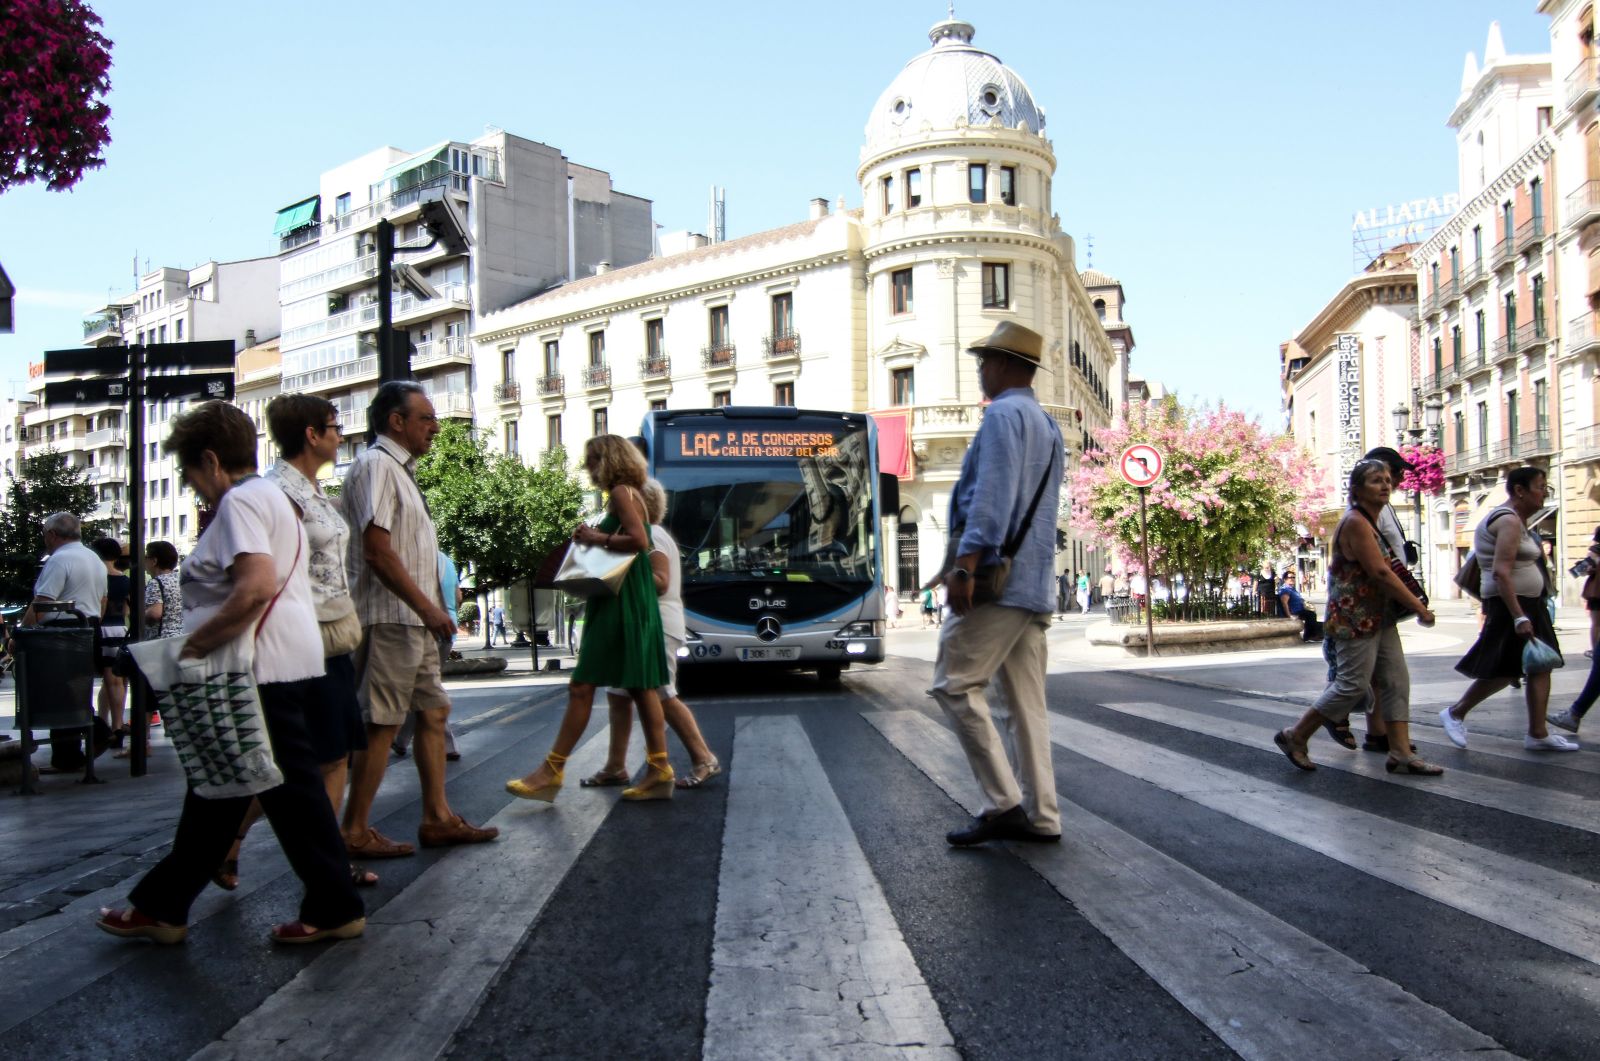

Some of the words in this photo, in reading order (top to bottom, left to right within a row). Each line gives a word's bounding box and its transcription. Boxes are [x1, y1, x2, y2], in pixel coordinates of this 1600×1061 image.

[1352, 193, 1459, 230] ALIATAR
[1340, 382, 1350, 421] Blanco
[1347, 384, 1360, 441] Blanco
[681, 433, 720, 456] LAC
[727, 432, 739, 446] P.
[742, 432, 759, 446] DE
[762, 432, 833, 446] CONGRESOS
[721, 446, 793, 457] CALETA-CRUZ
[796, 446, 814, 457] DEL
[817, 446, 839, 457] SUR
[766, 599, 786, 607] LAC
[825, 640, 845, 650] 432
